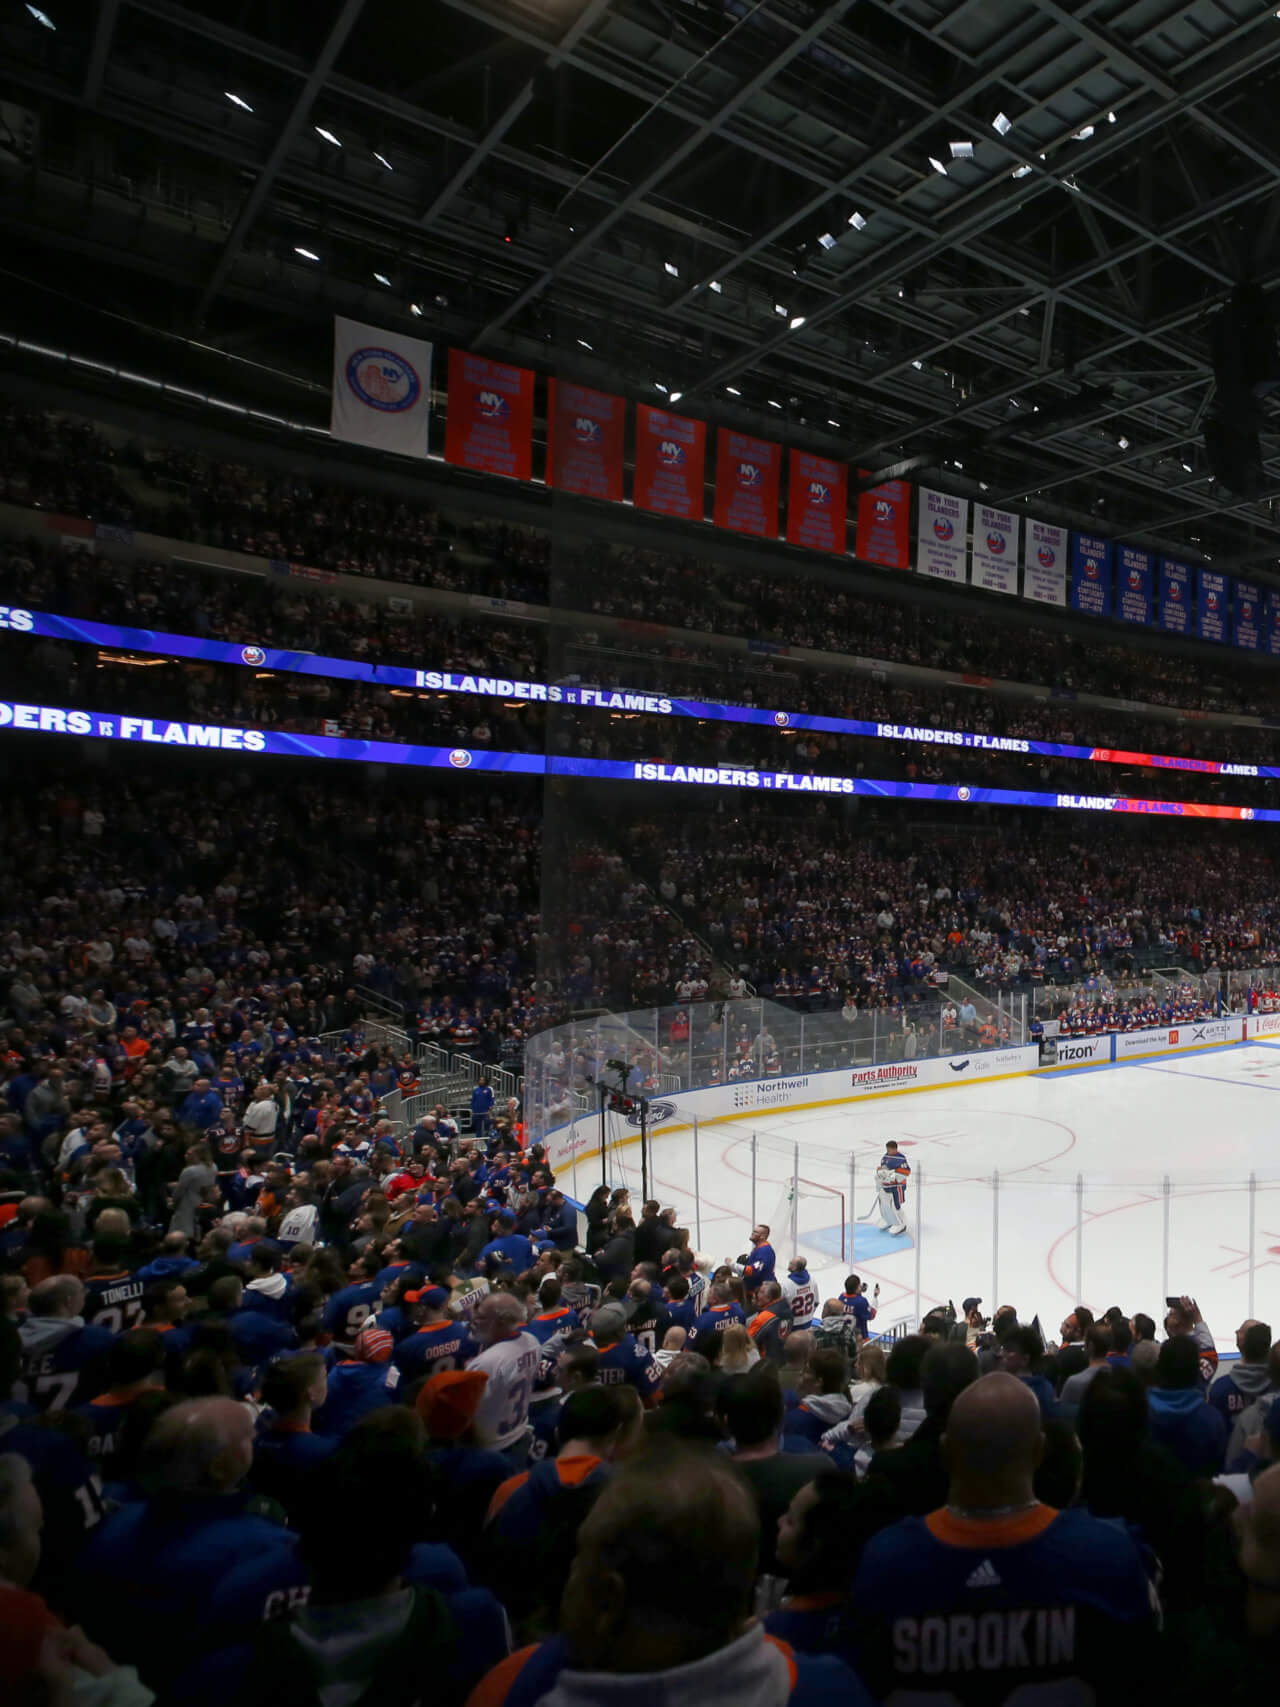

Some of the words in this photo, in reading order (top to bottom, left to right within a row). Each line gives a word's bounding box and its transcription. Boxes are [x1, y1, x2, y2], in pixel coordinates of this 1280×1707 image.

[415, 670, 562, 702] ISLANDERS
[581, 689, 673, 714] FLAMES
[120, 716, 266, 752] FLAMES
[877, 723, 963, 746] ISLANDERS
[973, 735, 1030, 753] FLAMES
[634, 763, 760, 788] ISLANDERS
[775, 773, 854, 793] FLAMES
[1057, 1045, 1093, 1061] rizon
[757, 1077, 809, 1095] Northwell
[852, 1070, 876, 1084] Parts
[877, 1064, 918, 1080] Authority
[756, 1092, 789, 1105] Health
[100, 1281, 144, 1306] TONELLI
[791, 1294, 815, 1317] 22
[892, 1604, 1077, 1677] SOROKIN
